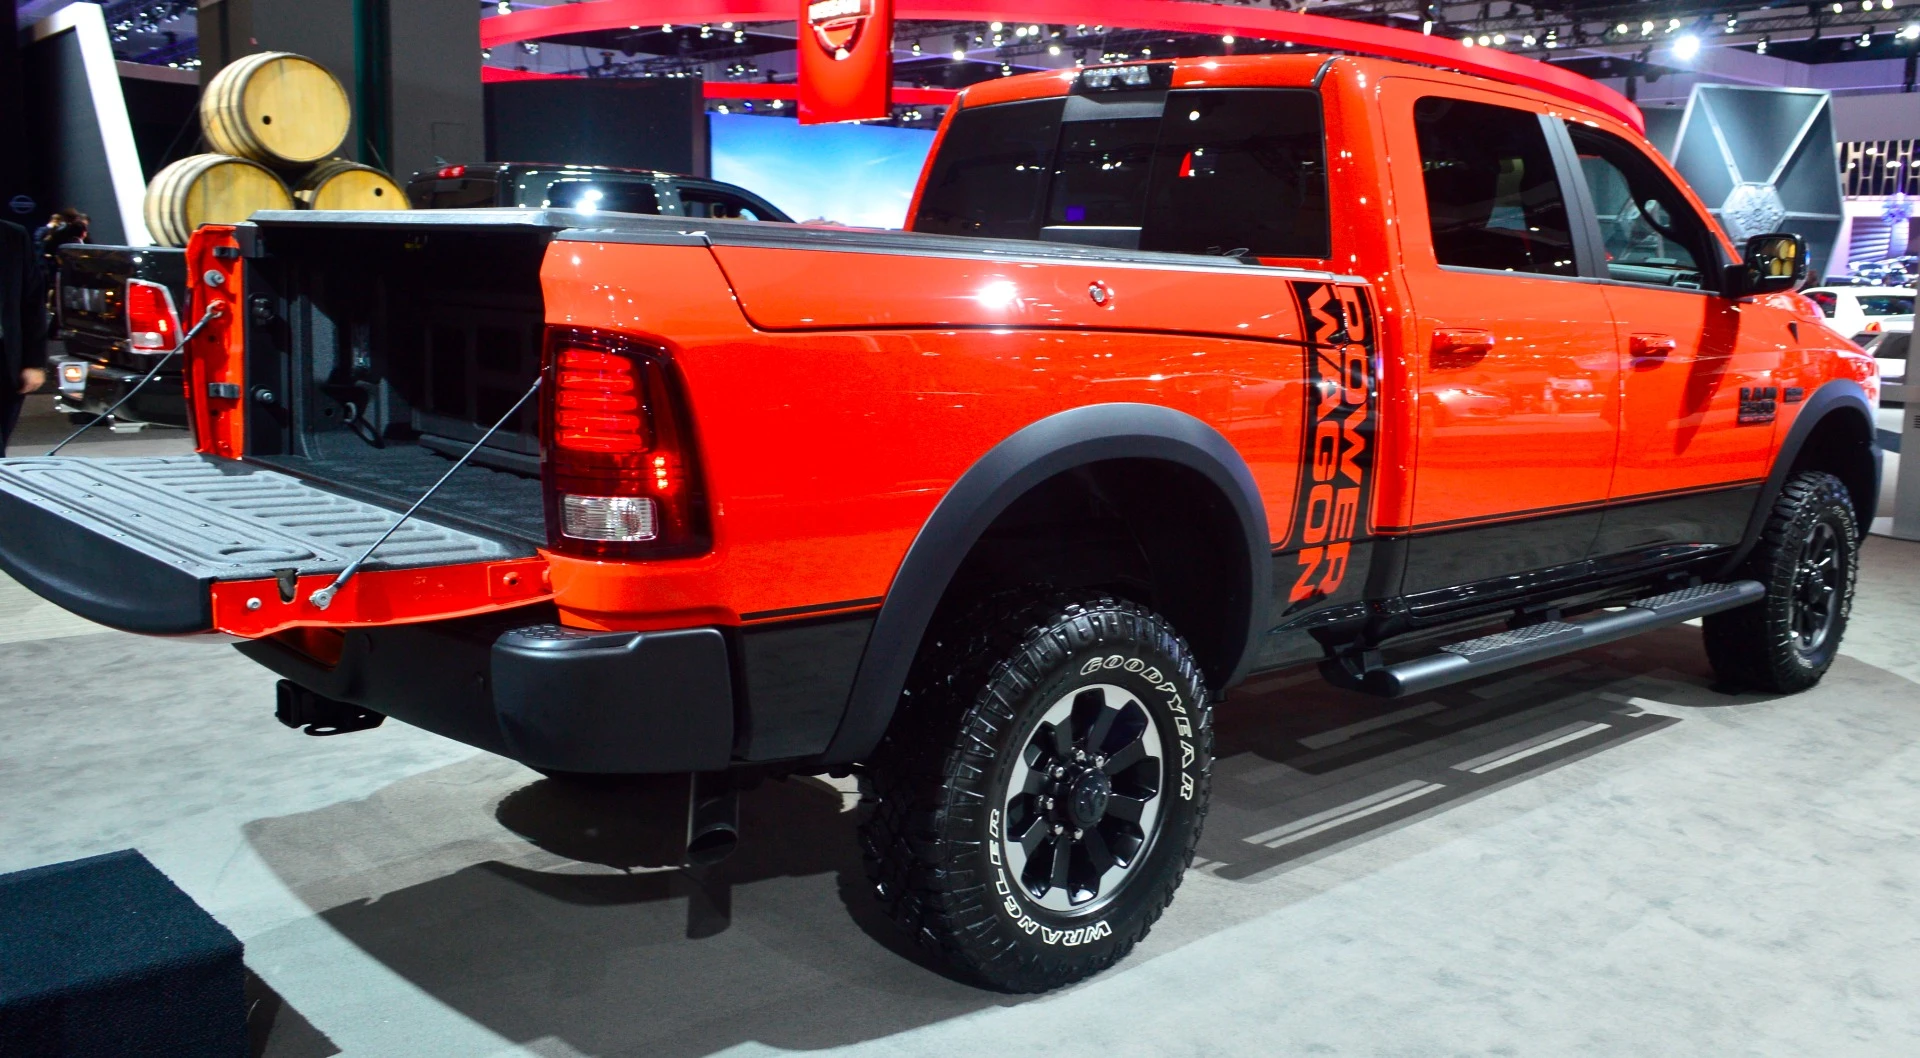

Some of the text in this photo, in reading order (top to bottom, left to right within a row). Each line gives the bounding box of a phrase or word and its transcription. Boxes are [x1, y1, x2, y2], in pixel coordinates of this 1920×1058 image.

[1288, 284, 1342, 603] WAGON
[1319, 286, 1368, 594] POWER
[1739, 387, 1777, 401] RAM
[1080, 654, 1195, 801] GOODYEAR
[989, 808, 1112, 946] WRANGLER
